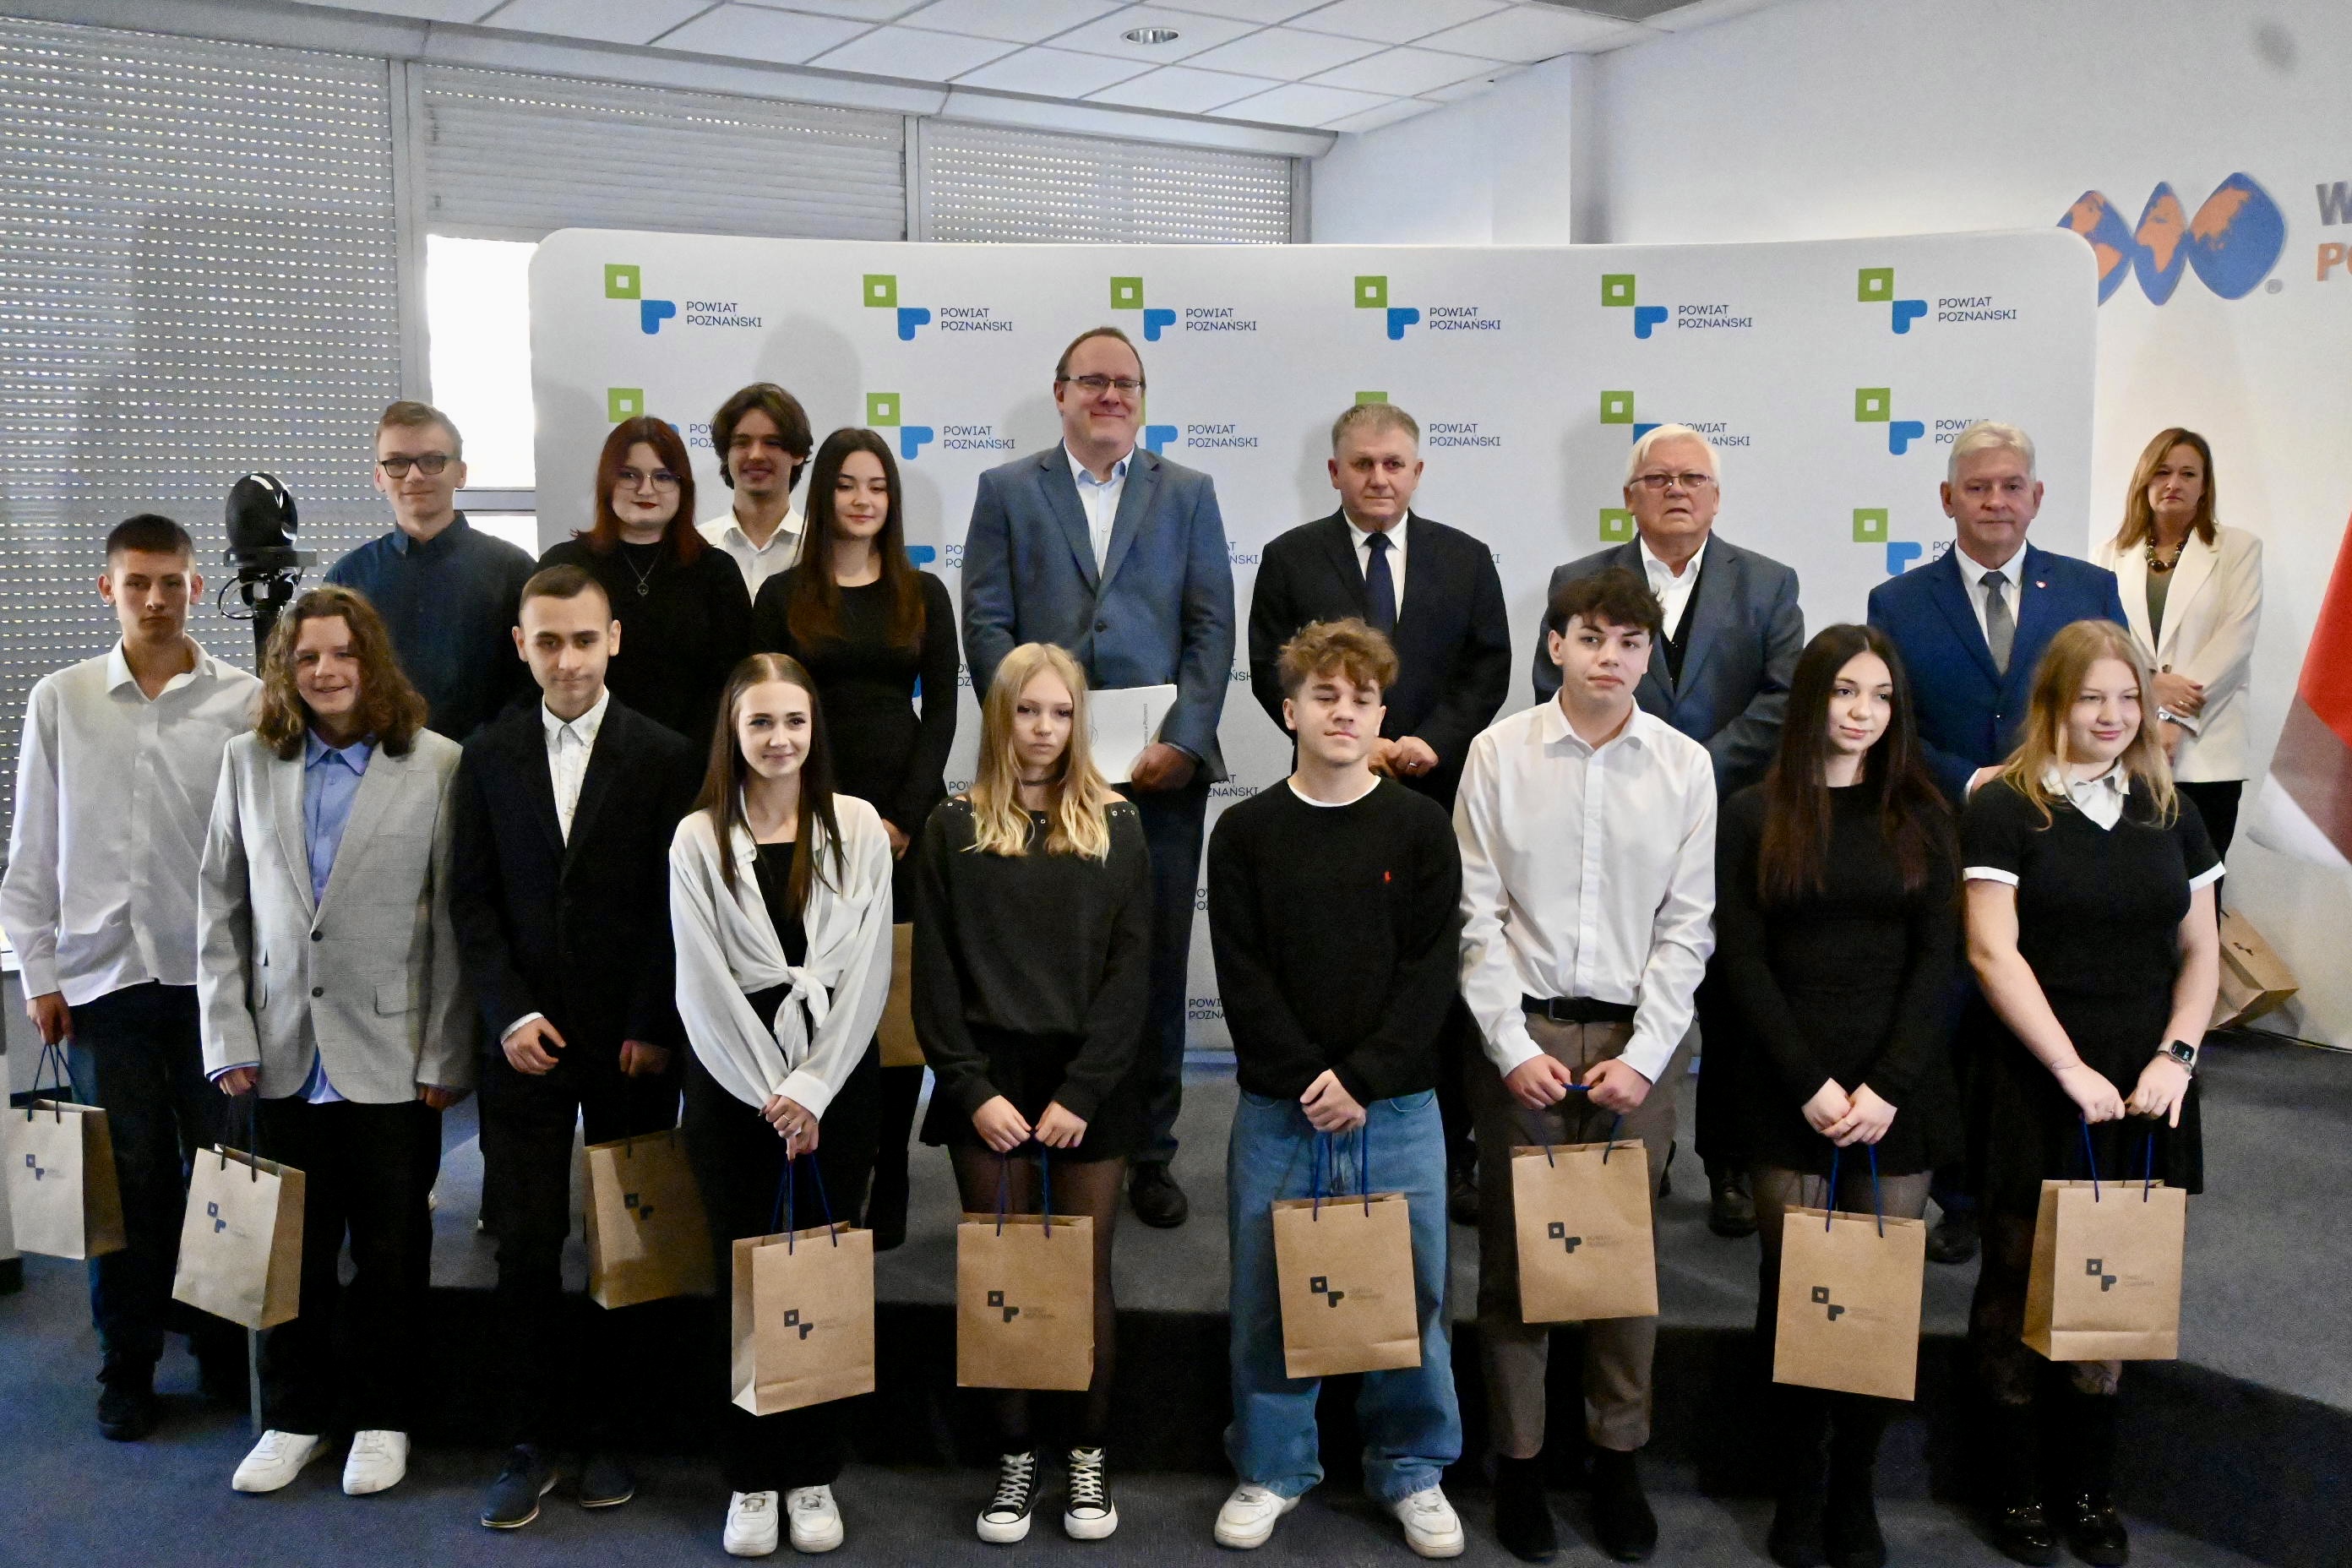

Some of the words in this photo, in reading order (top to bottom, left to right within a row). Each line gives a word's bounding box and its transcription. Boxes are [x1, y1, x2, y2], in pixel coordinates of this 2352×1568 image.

[687, 302, 738, 313] POWIAT
[1939, 297, 1991, 308] POWIAT
[941, 308, 989, 318] POWIAT
[1186, 308, 1233, 318] POWIAT
[1430, 307, 1478, 317] POWIAT
[1679, 304, 1729, 315] POWIAT
[1939, 308, 2017, 322] POZNAŃSKI
[687, 314, 762, 328] POZNAŃSKI
[941, 319, 1012, 331] POZNAŃSKI
[1186, 318, 1256, 331] POZNAŃSKI
[1430, 318, 1500, 330] POZNAŃSKI
[1679, 316, 1752, 329] POZNAŃSKI
[944, 425, 992, 436] POWIAT
[1188, 424, 1235, 434] POWIAT
[1430, 423, 1478, 433] POWIAT
[944, 437, 1015, 449] POZNAŃSKI
[1188, 436, 1257, 448] POZNAŃSKI
[1430, 435, 1500, 447] POZNAŃSKI
